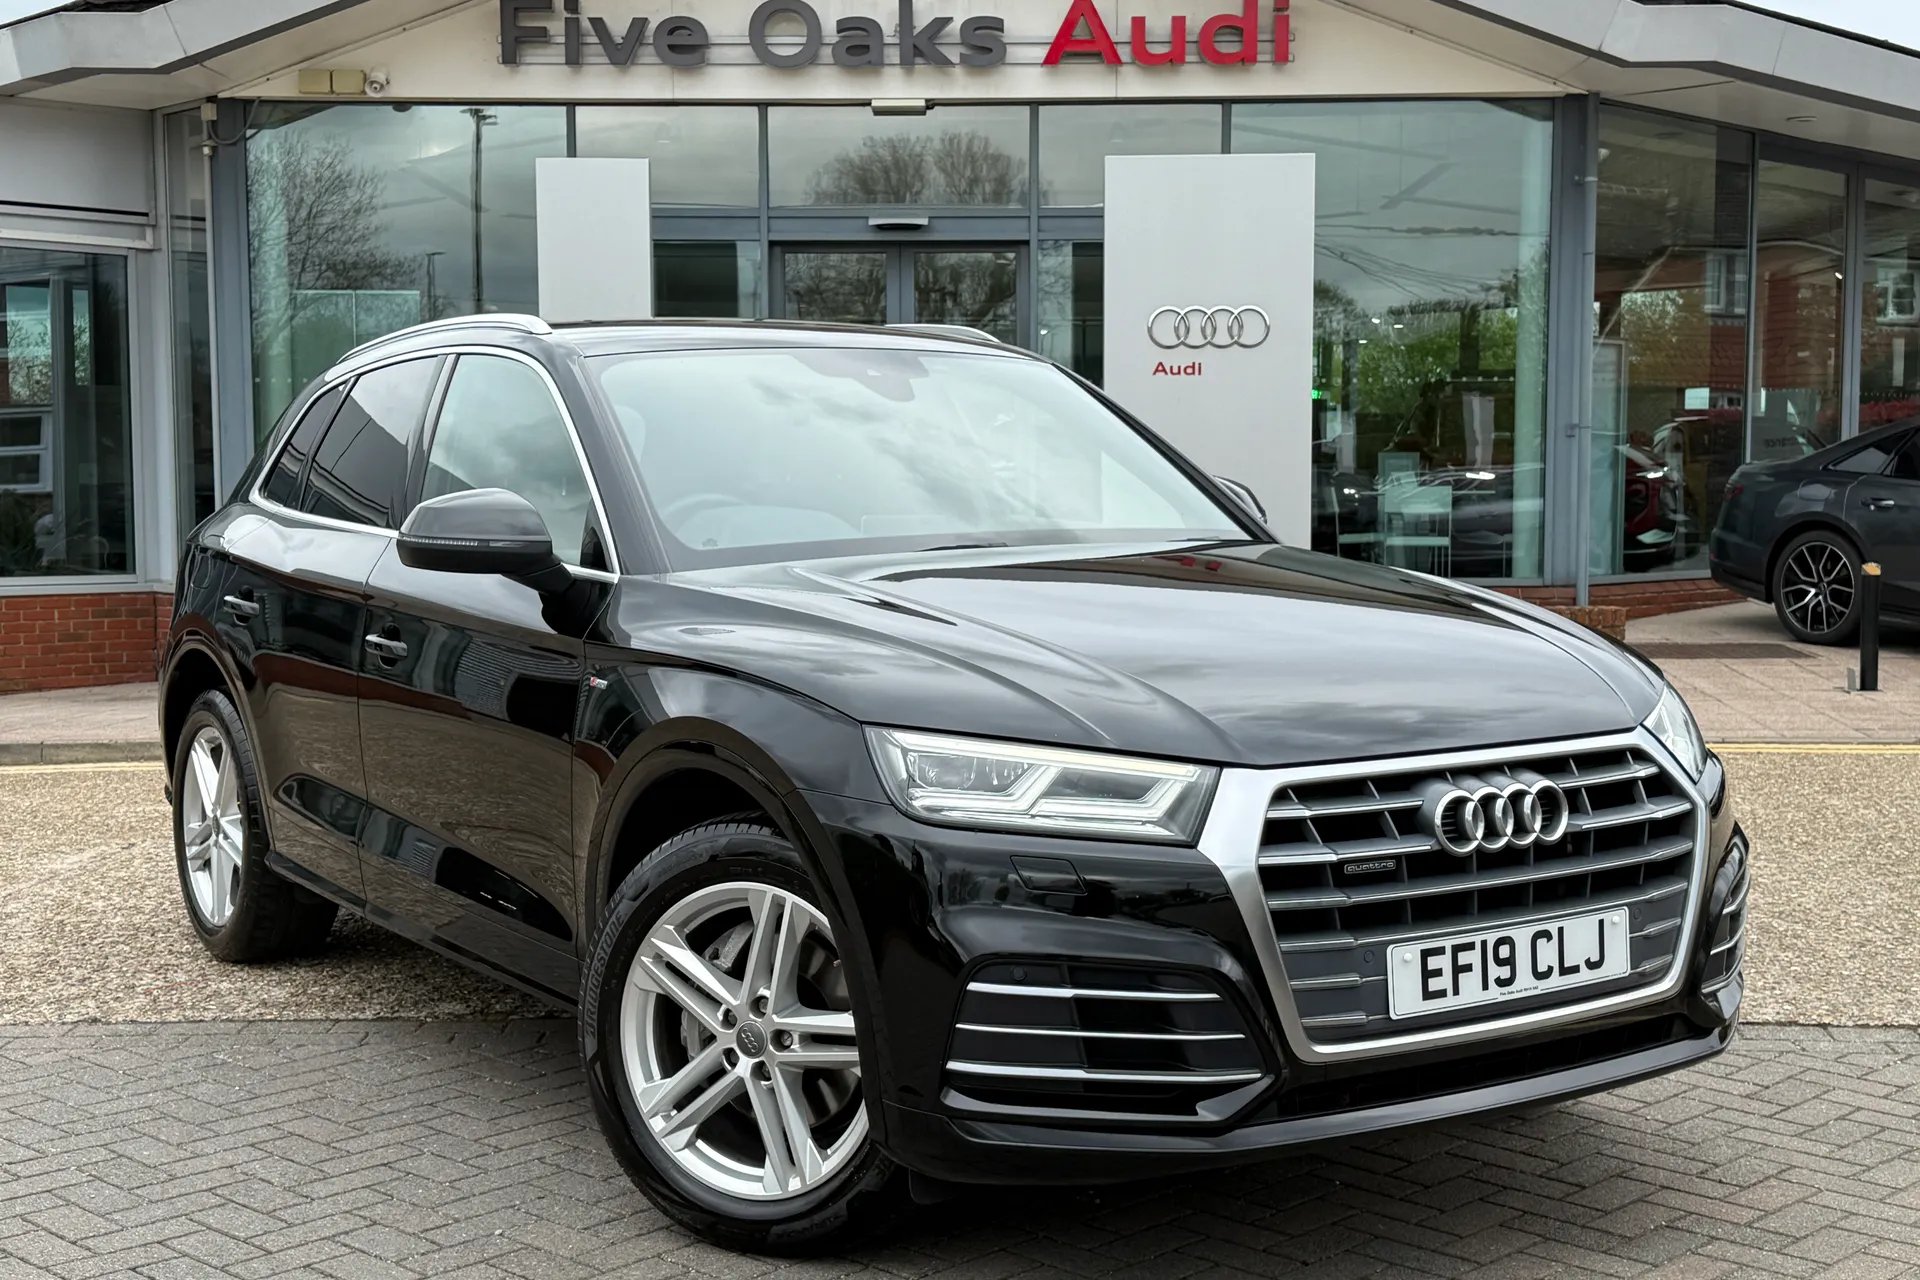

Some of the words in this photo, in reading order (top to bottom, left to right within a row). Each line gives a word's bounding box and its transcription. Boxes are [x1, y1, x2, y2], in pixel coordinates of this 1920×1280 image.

[500, 0, 710, 68] Five
[748, 0, 1007, 69] Oaks
[1041, 0, 1290, 67] Audi
[1152, 361, 1202, 376] Audi
[1347, 862, 1394, 872] quattro
[1420, 935, 1517, 1002] EF19
[1531, 918, 1606, 981] CLJ
